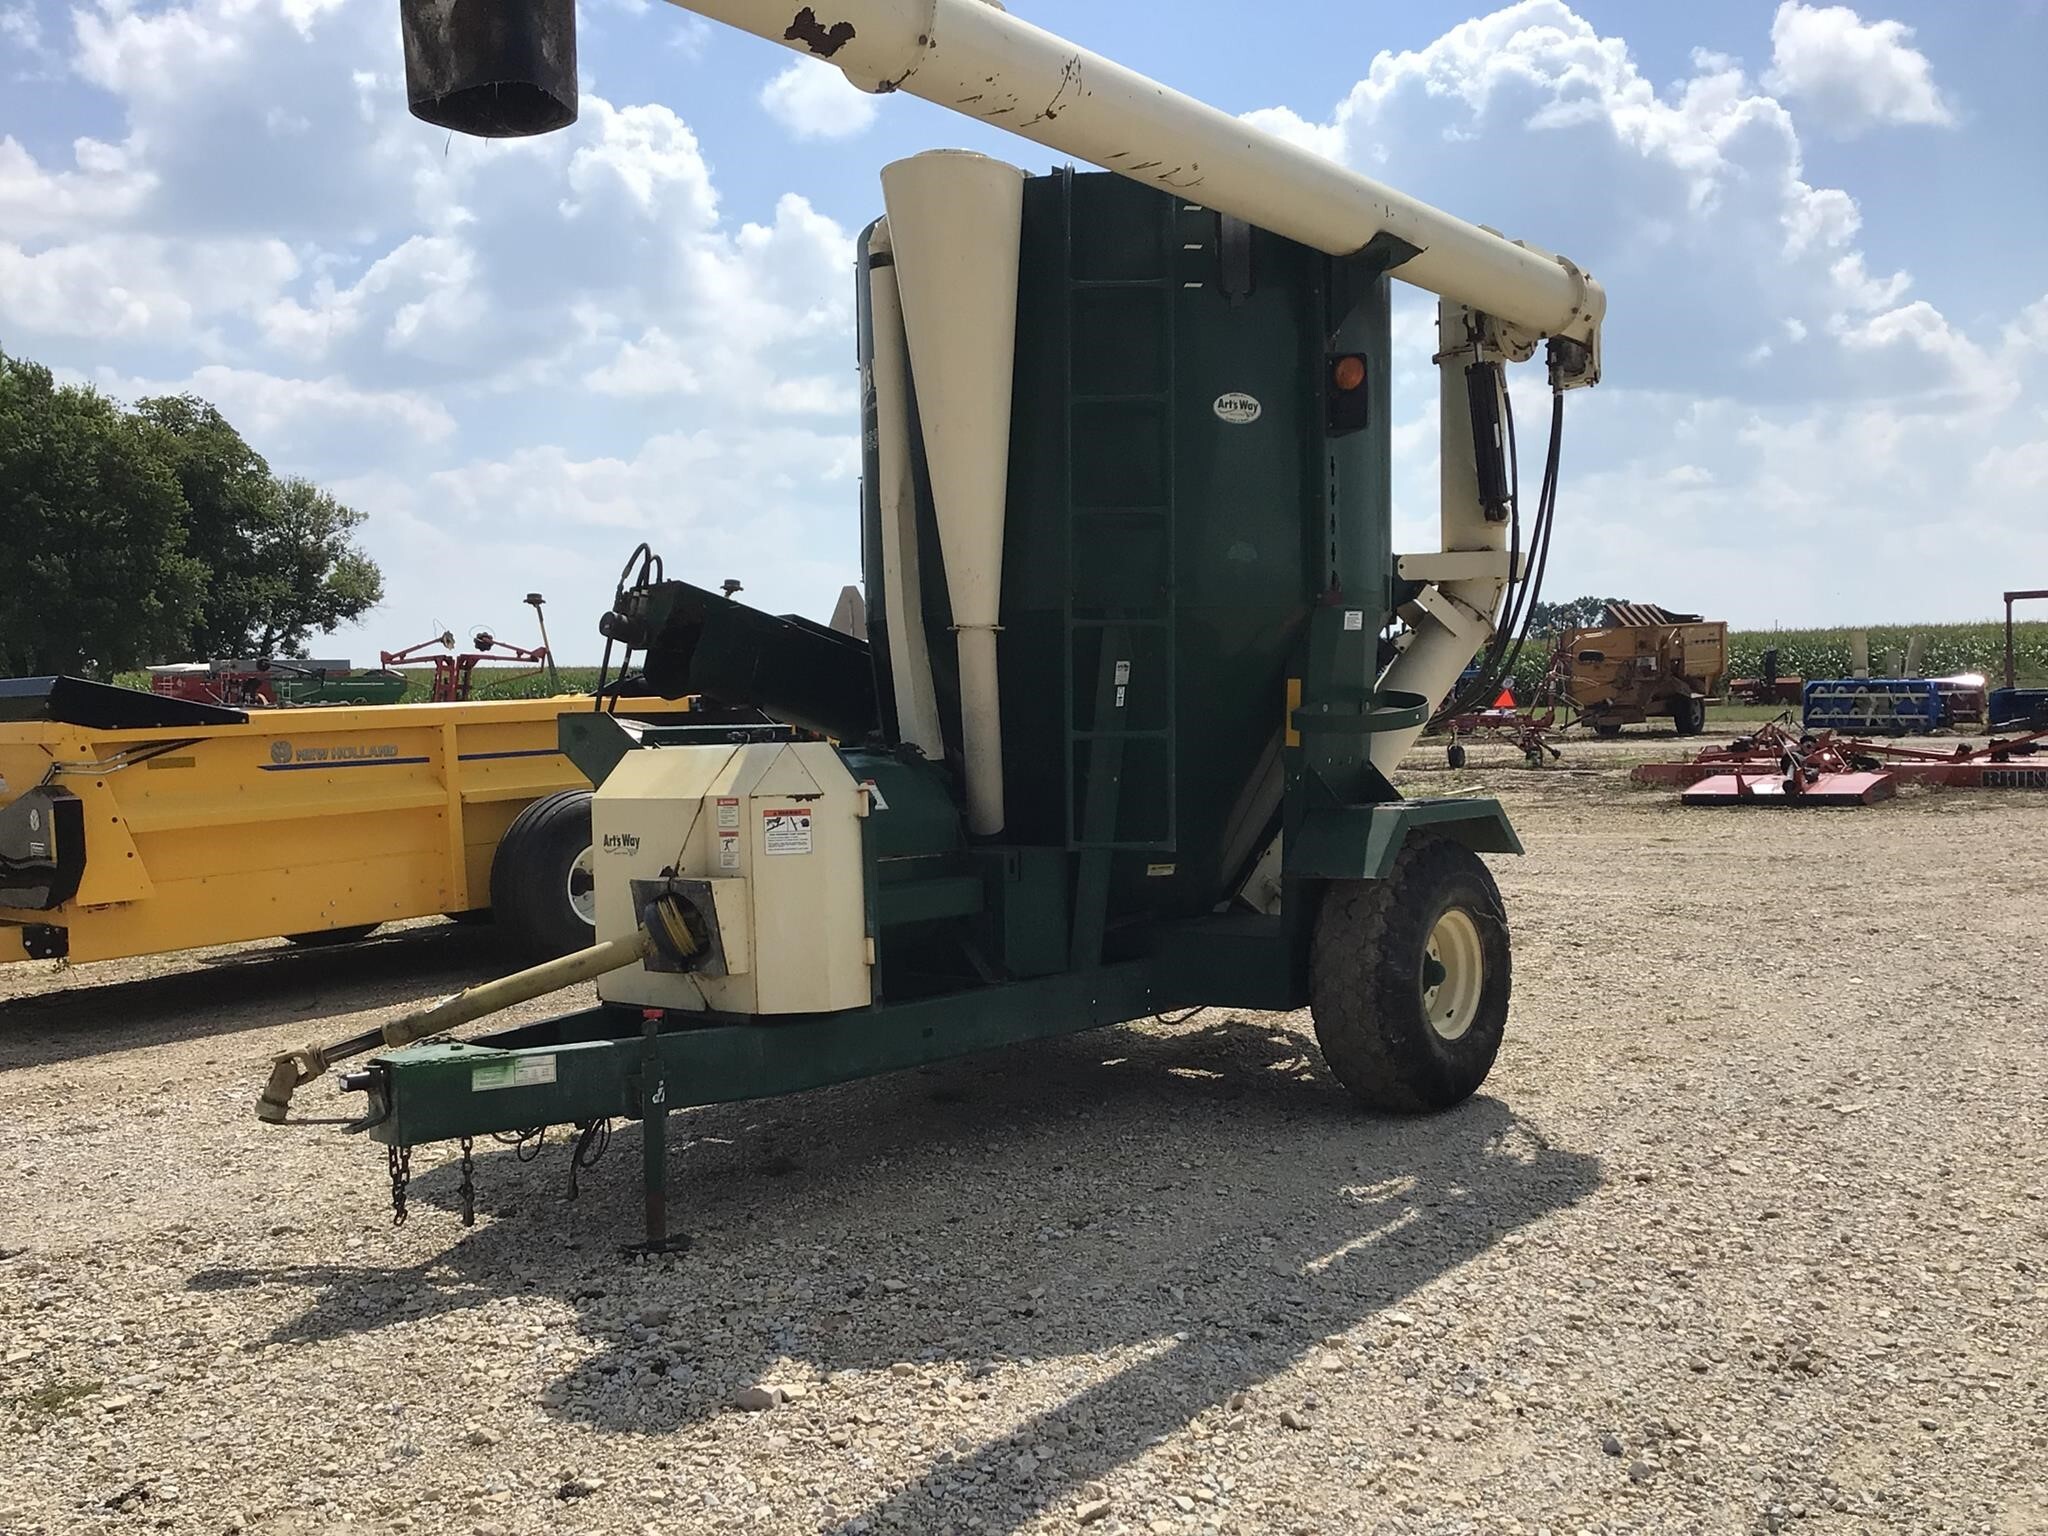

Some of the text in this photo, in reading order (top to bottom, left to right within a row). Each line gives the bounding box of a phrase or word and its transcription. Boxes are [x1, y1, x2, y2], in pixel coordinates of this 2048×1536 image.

[1218, 398, 1258, 413] Art's Way
[296, 744, 398, 761] NEW HOLLAND
[603, 833, 640, 849] Art's Way
